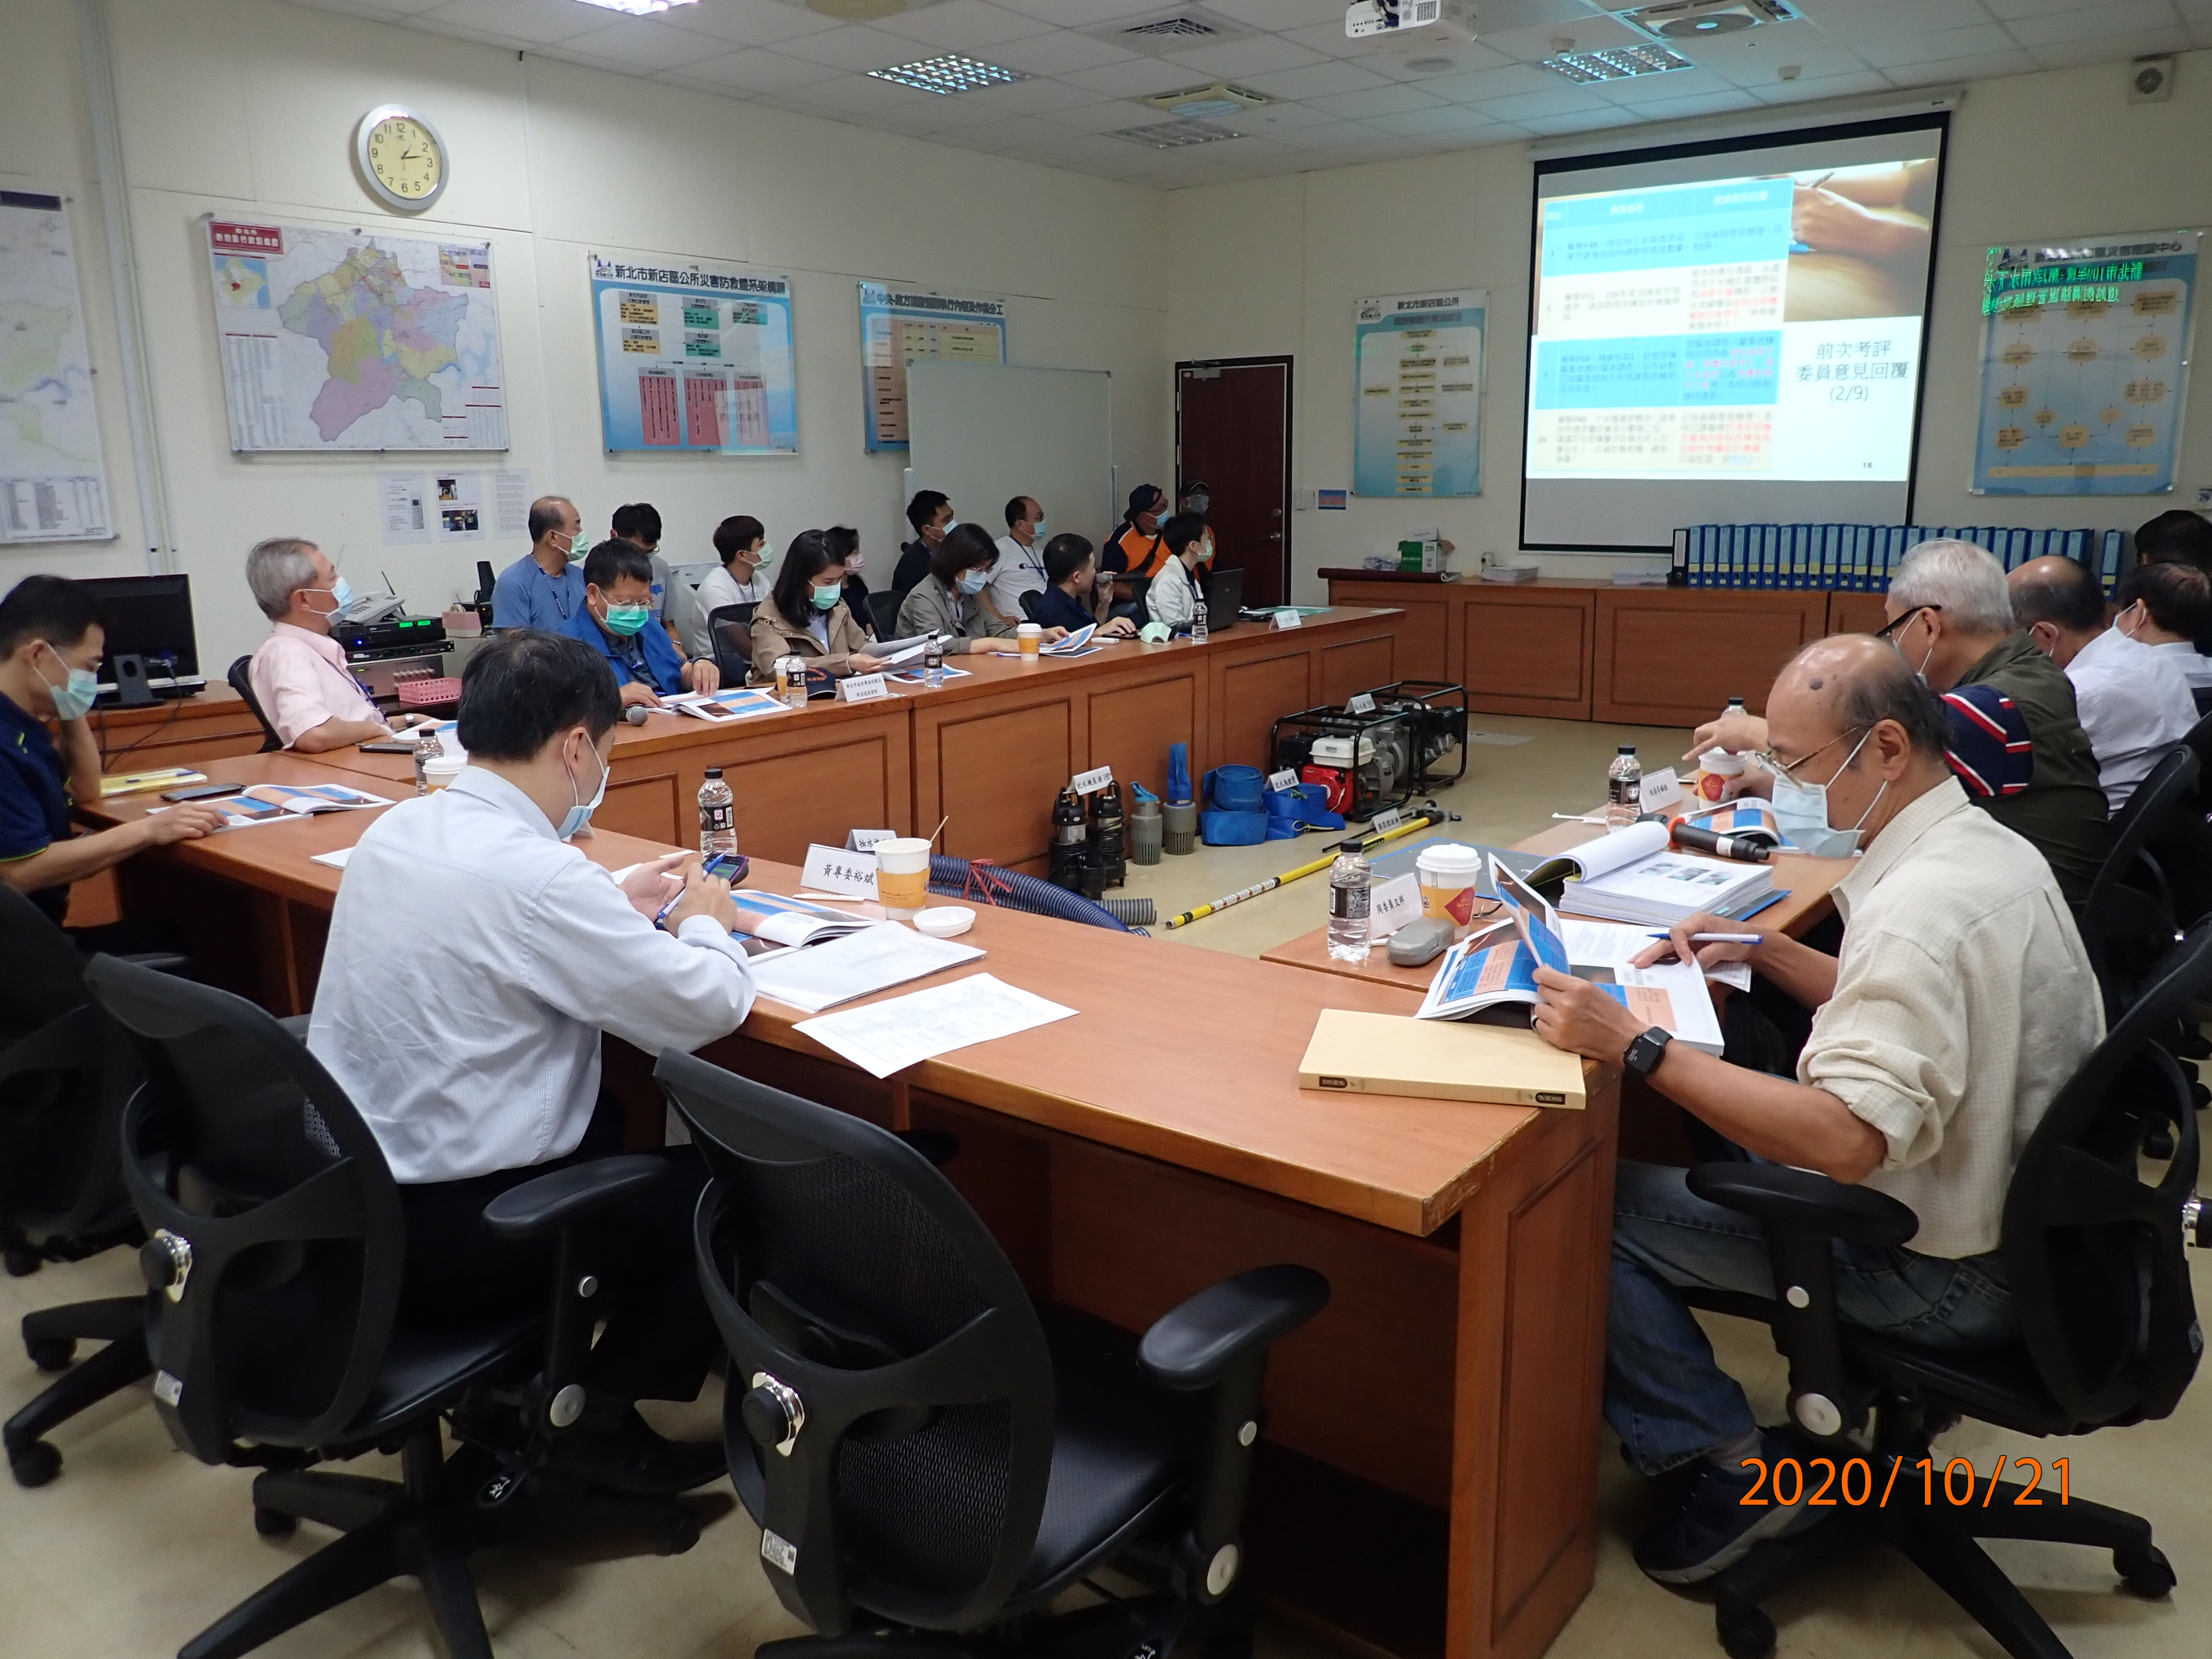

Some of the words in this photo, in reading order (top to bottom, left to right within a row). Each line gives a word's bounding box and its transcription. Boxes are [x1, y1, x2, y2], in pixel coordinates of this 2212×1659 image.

[384, 124, 392, 134] 11
[397, 123, 405, 132] 12
[375, 134, 383, 143] 10
[422, 143, 428, 152] 2
[372, 148, 378, 158] 9
[427, 158, 433, 168] 3
[377, 164, 383, 174] 8
[388, 177, 394, 186] 7
[424, 173, 429, 181] 4
[401, 183, 408, 193] 6
[415, 181, 420, 191] 5
[1817, 340, 1891, 359] 前次考評
[1797, 362, 1908, 381] 委員意見回覆
[1830, 385, 1868, 402] (2/9)
